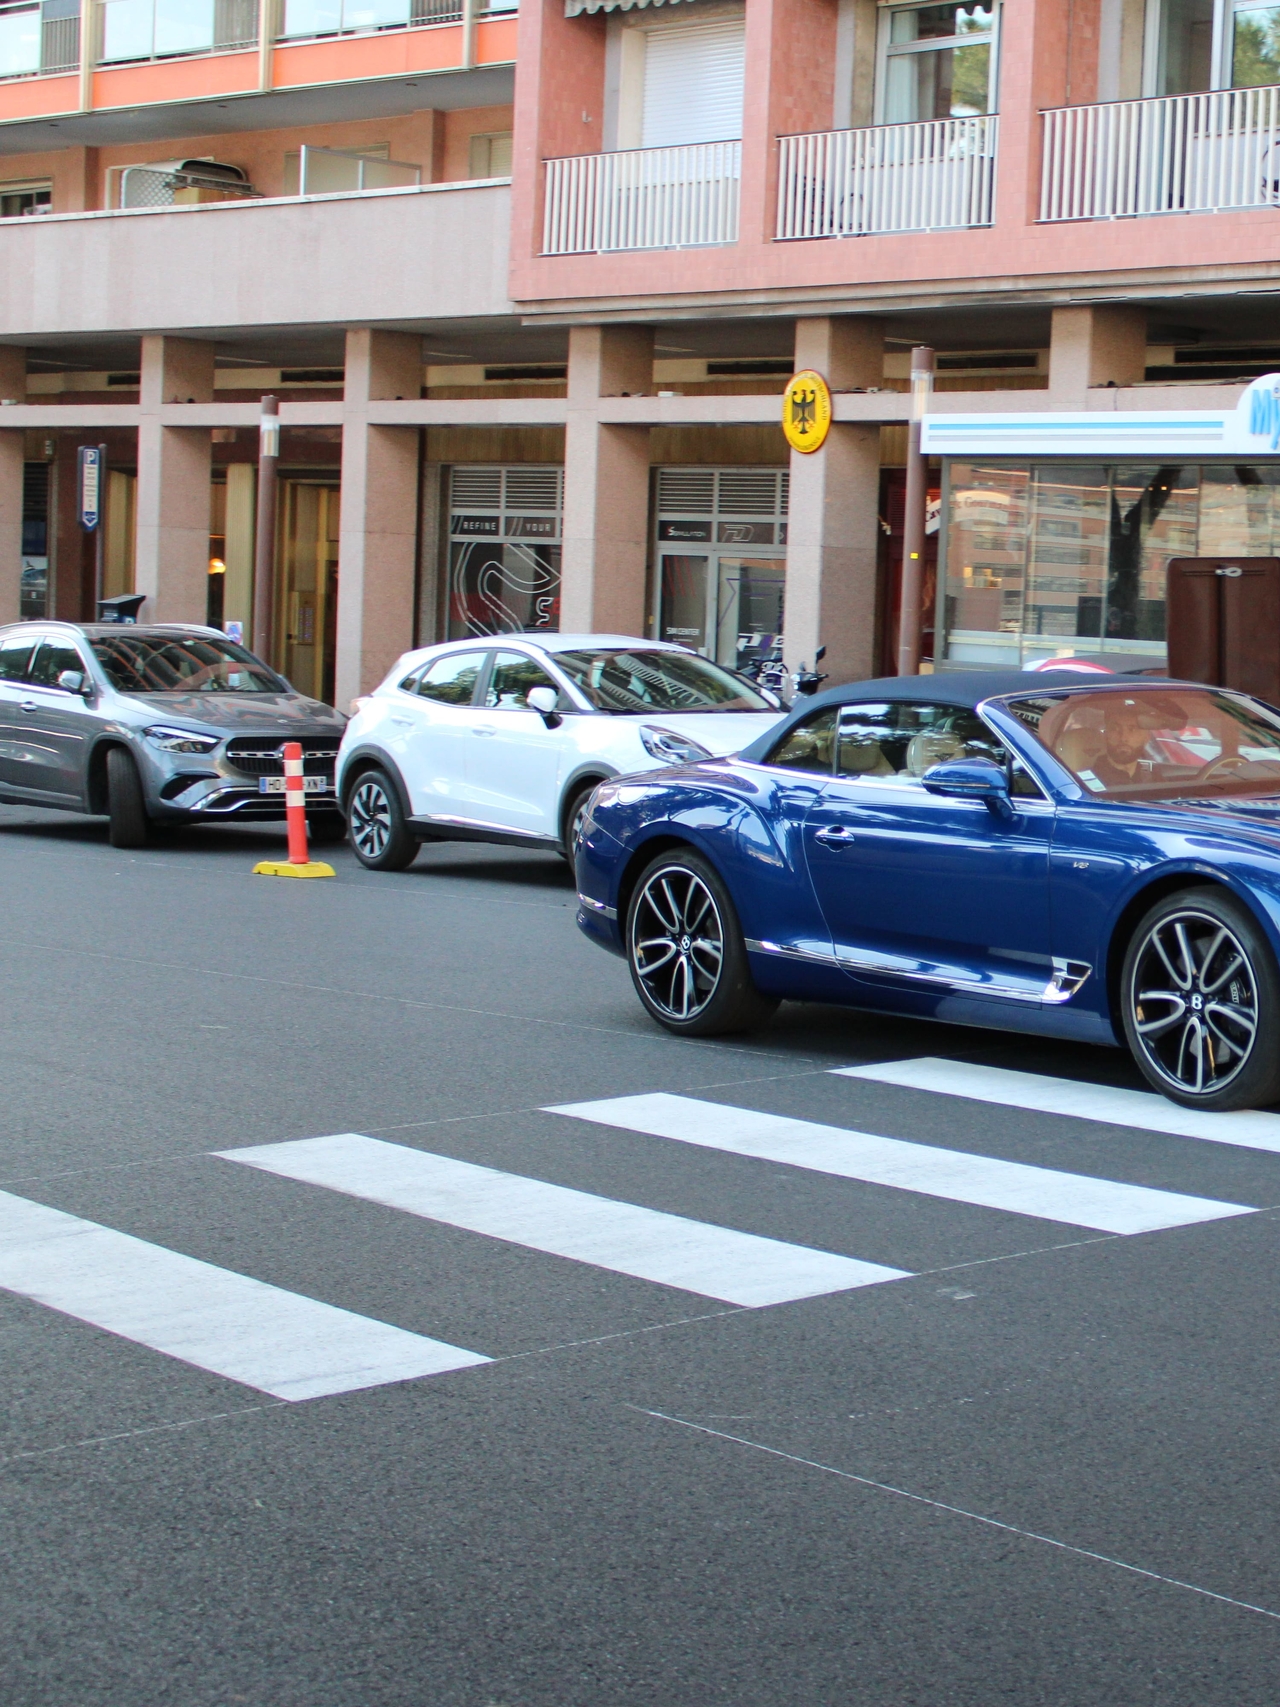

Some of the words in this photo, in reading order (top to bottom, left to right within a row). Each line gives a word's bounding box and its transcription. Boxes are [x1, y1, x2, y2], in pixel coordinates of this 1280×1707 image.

[86, 451, 96, 464] P
[463, 521, 497, 531] REFINE
[526, 523, 551, 532] YOUR
